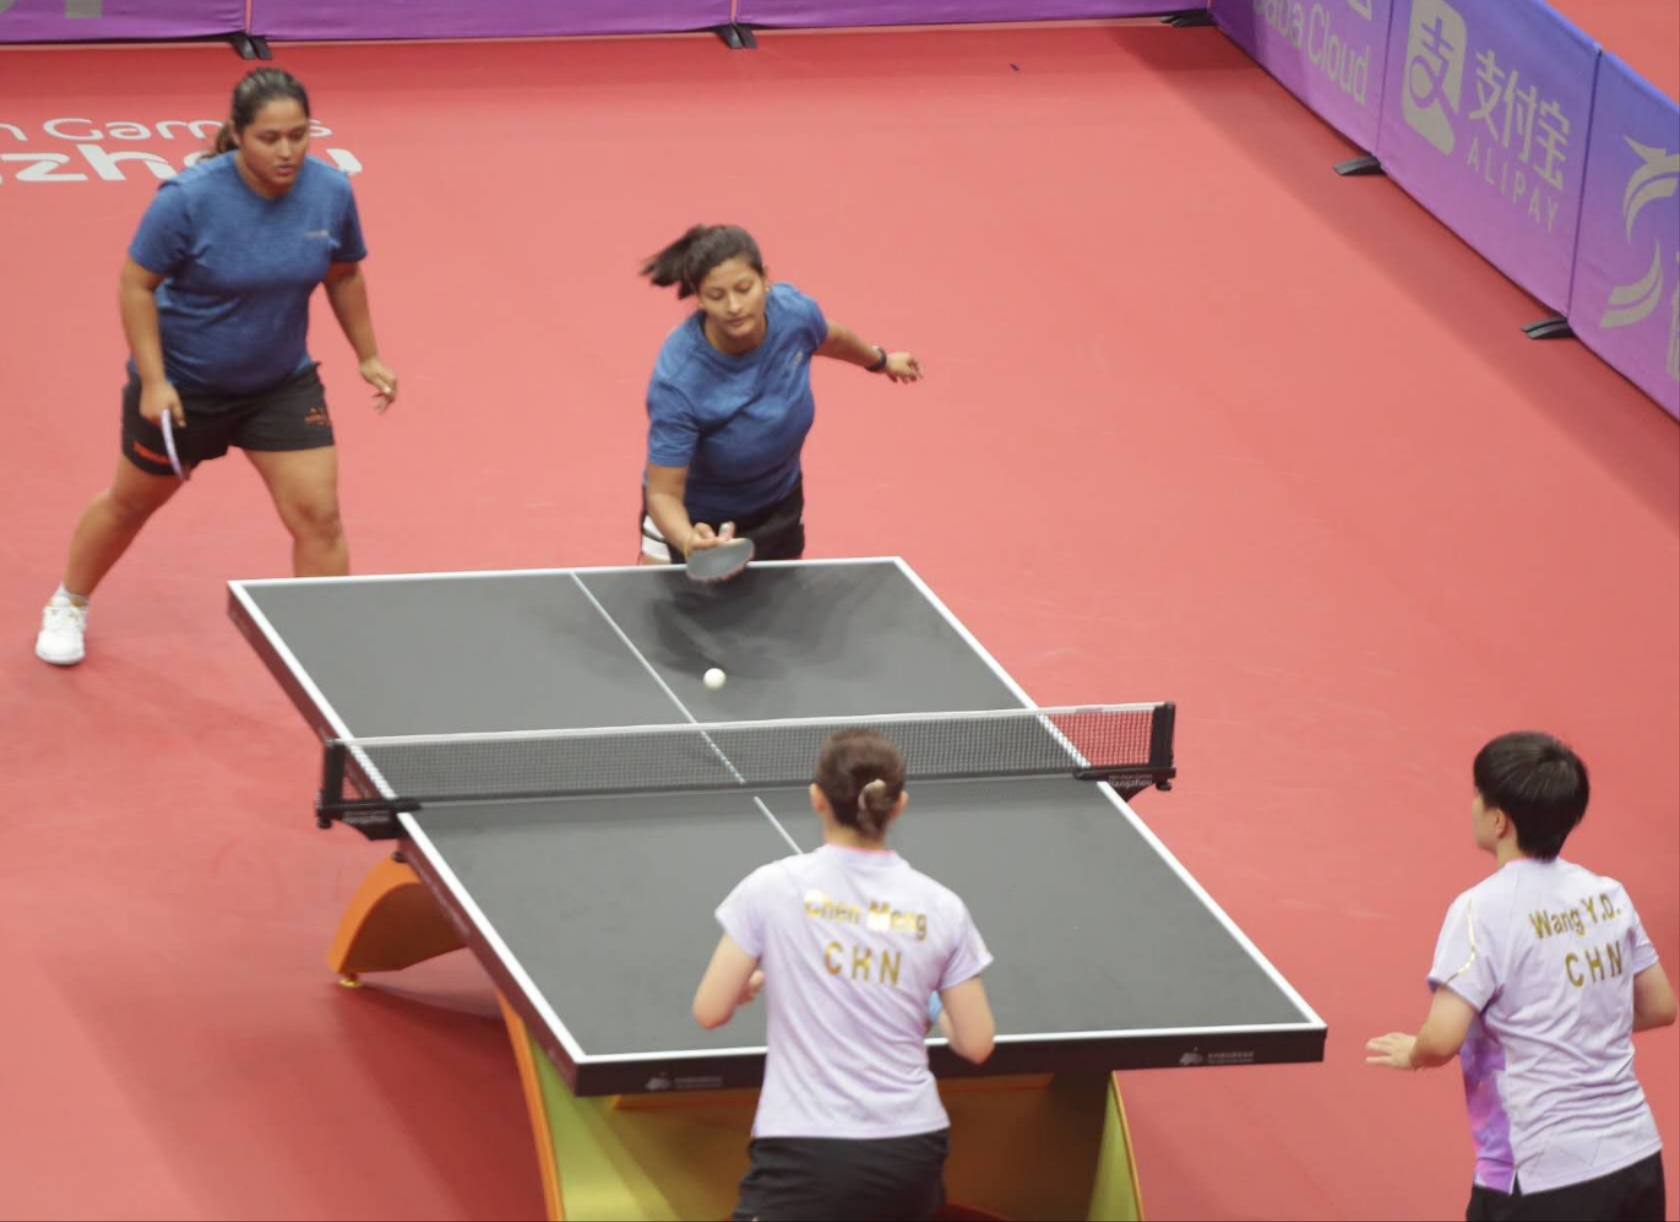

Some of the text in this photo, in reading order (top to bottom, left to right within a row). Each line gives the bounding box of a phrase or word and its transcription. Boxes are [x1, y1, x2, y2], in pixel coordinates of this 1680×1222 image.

[1308, 3, 1372, 107] Cloud
[43, 117, 333, 141] Gams
[1468, 49, 1570, 193] 支付宝
[1466, 136, 1559, 232] ALIPAY
[1529, 892, 1622, 940] Wang Y.D.
[823, 940, 902, 985] CHN
[1565, 940, 1623, 988] CHN
